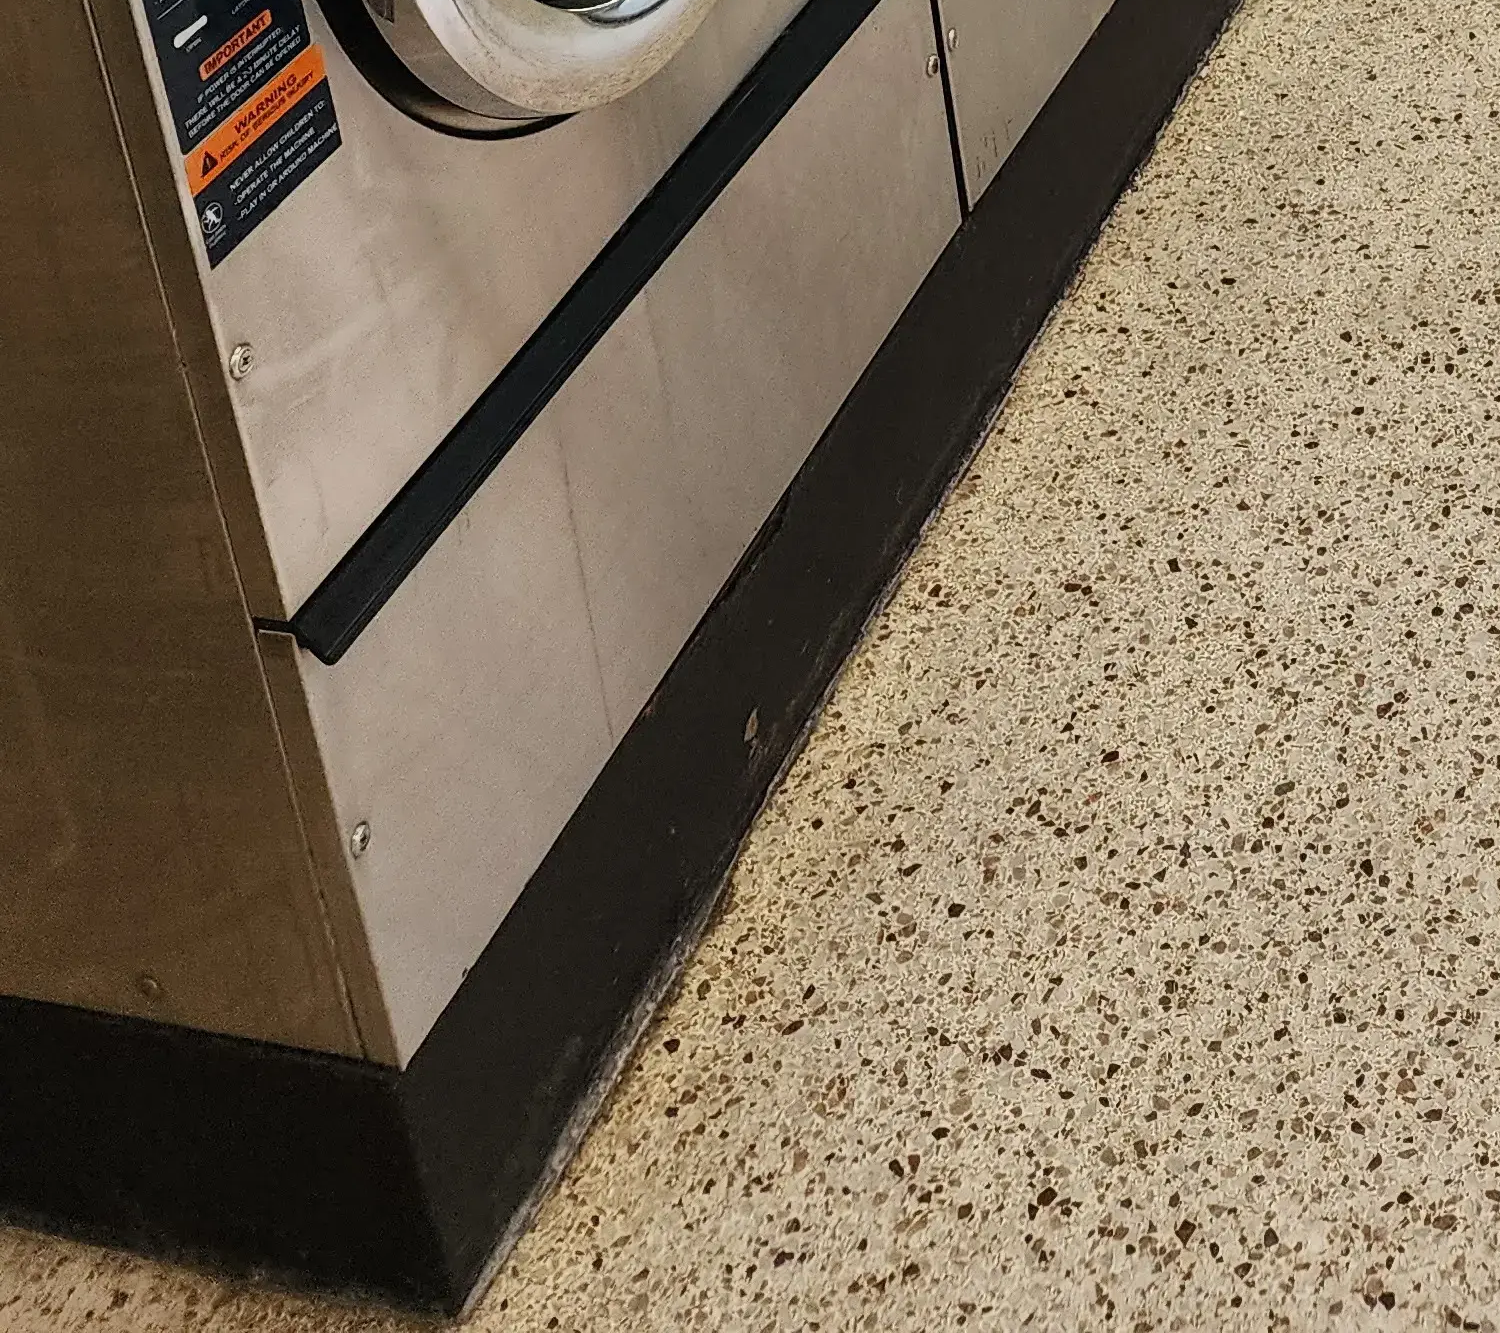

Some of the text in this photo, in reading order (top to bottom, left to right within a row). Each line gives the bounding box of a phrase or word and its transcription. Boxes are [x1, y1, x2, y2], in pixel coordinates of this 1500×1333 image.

[203, 14, 265, 73] IMPORTANT
[278, 24, 299, 47] DELAY
[188, 109, 215, 138] BEFORE
[230, 80, 250, 101] DOOR
[250, 66, 264, 83] CAN
[234, 73, 296, 133] WARNING
[229, 165, 253, 191] NEVER
[254, 141, 278, 168] ALLOW
[279, 109, 313, 144] CHILDREN
[258, 189, 266, 201] IN
[266, 178, 277, 192] OR
[278, 151, 306, 183] AROUND
[307, 122, 337, 154] MACHINE
[269, 155, 282, 171] THE
[283, 126, 314, 159] MACHINE
